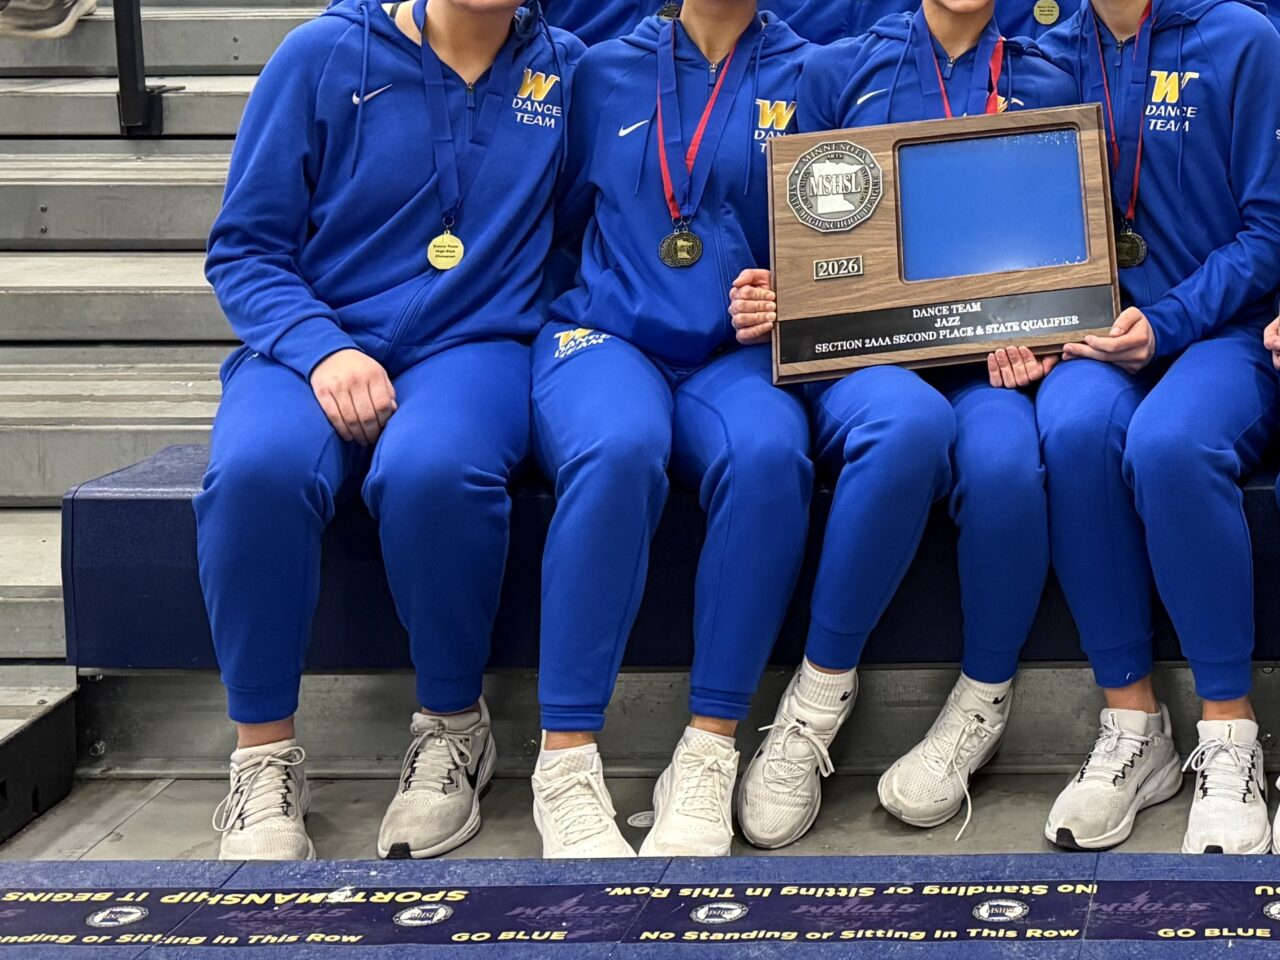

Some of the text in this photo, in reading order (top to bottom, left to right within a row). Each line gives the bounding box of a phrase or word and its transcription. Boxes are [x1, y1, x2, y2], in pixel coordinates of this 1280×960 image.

[517, 67, 560, 101] W
[1150, 70, 1200, 104] W
[512, 97, 562, 117] DANCE
[754, 98, 797, 130] W
[1145, 104, 1198, 118] DANCE
[515, 112, 556, 129] TEAM
[1148, 119, 1190, 132] TEAM
[801, 143, 866, 163] MINNESOTA
[809, 173, 861, 197] MSHSL
[789, 184, 801, 210] STATE
[800, 211, 822, 228] HIGH
[825, 213, 861, 229] SCHOOL
[863, 176, 880, 213] LEAGUE
[817, 259, 859, 277] 2026
[912, 302, 982, 319] DANCE TEAM
[934, 315, 961, 328] JAZZ
[815, 315, 1079, 354] SECTION 2AAA SECOND PLACE & STATE QUALIFIER
[1, 890, 470, 904] SPORTSMANSHIP IT BEGINS
[604, 883, 1098, 898] No Standing or Sitting This Row.
[82, 935, 113, 944] or
[247, 933, 301, 944] This
[305, 933, 364, 943] Row
[451, 930, 569, 942] GO BLUE
[639, 930, 675, 940] No
[682, 929, 798, 941] Standing
[805, 930, 834, 940] or
[839, 928, 927, 940] Sitting
[966, 928, 1018, 938] This
[1025, 928, 1080, 938] Row
[1157, 927, 1272, 938] GO BLUE
